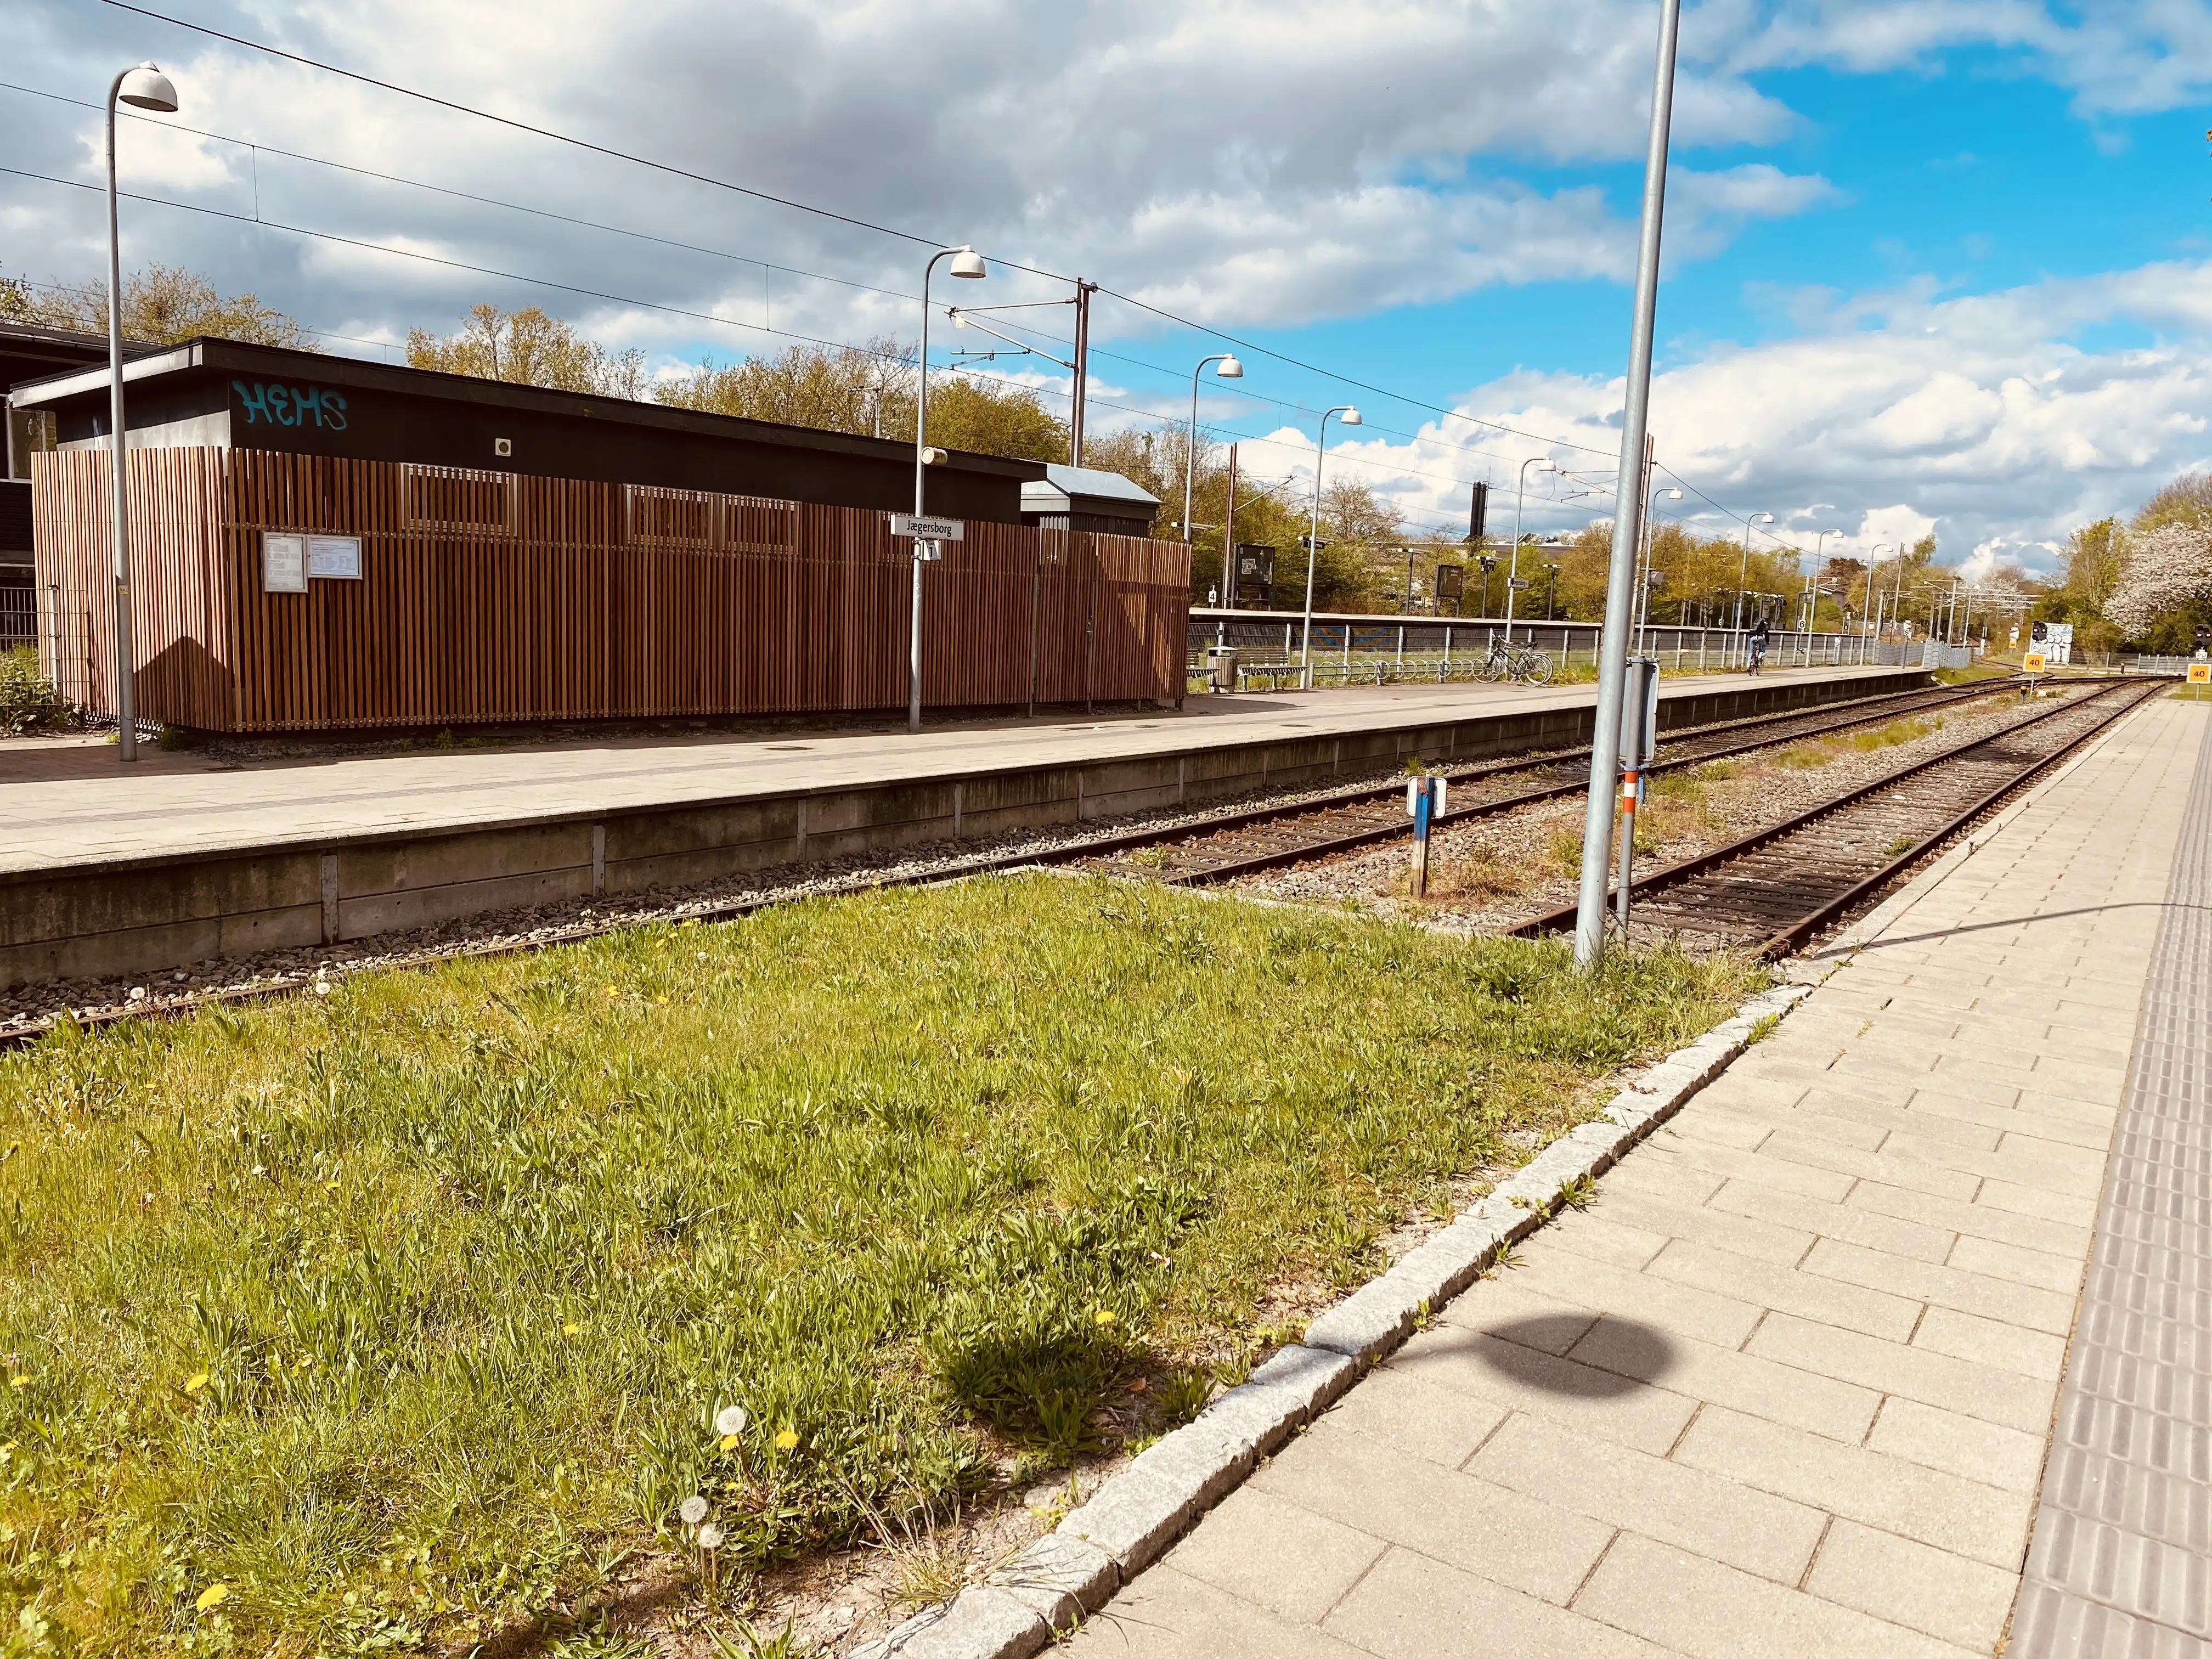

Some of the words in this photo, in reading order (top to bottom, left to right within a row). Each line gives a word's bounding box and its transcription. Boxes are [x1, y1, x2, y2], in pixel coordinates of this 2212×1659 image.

[907, 520, 952, 537] Jægersborg
[929, 546, 933, 557] 1
[1210, 592, 1215, 601] 4
